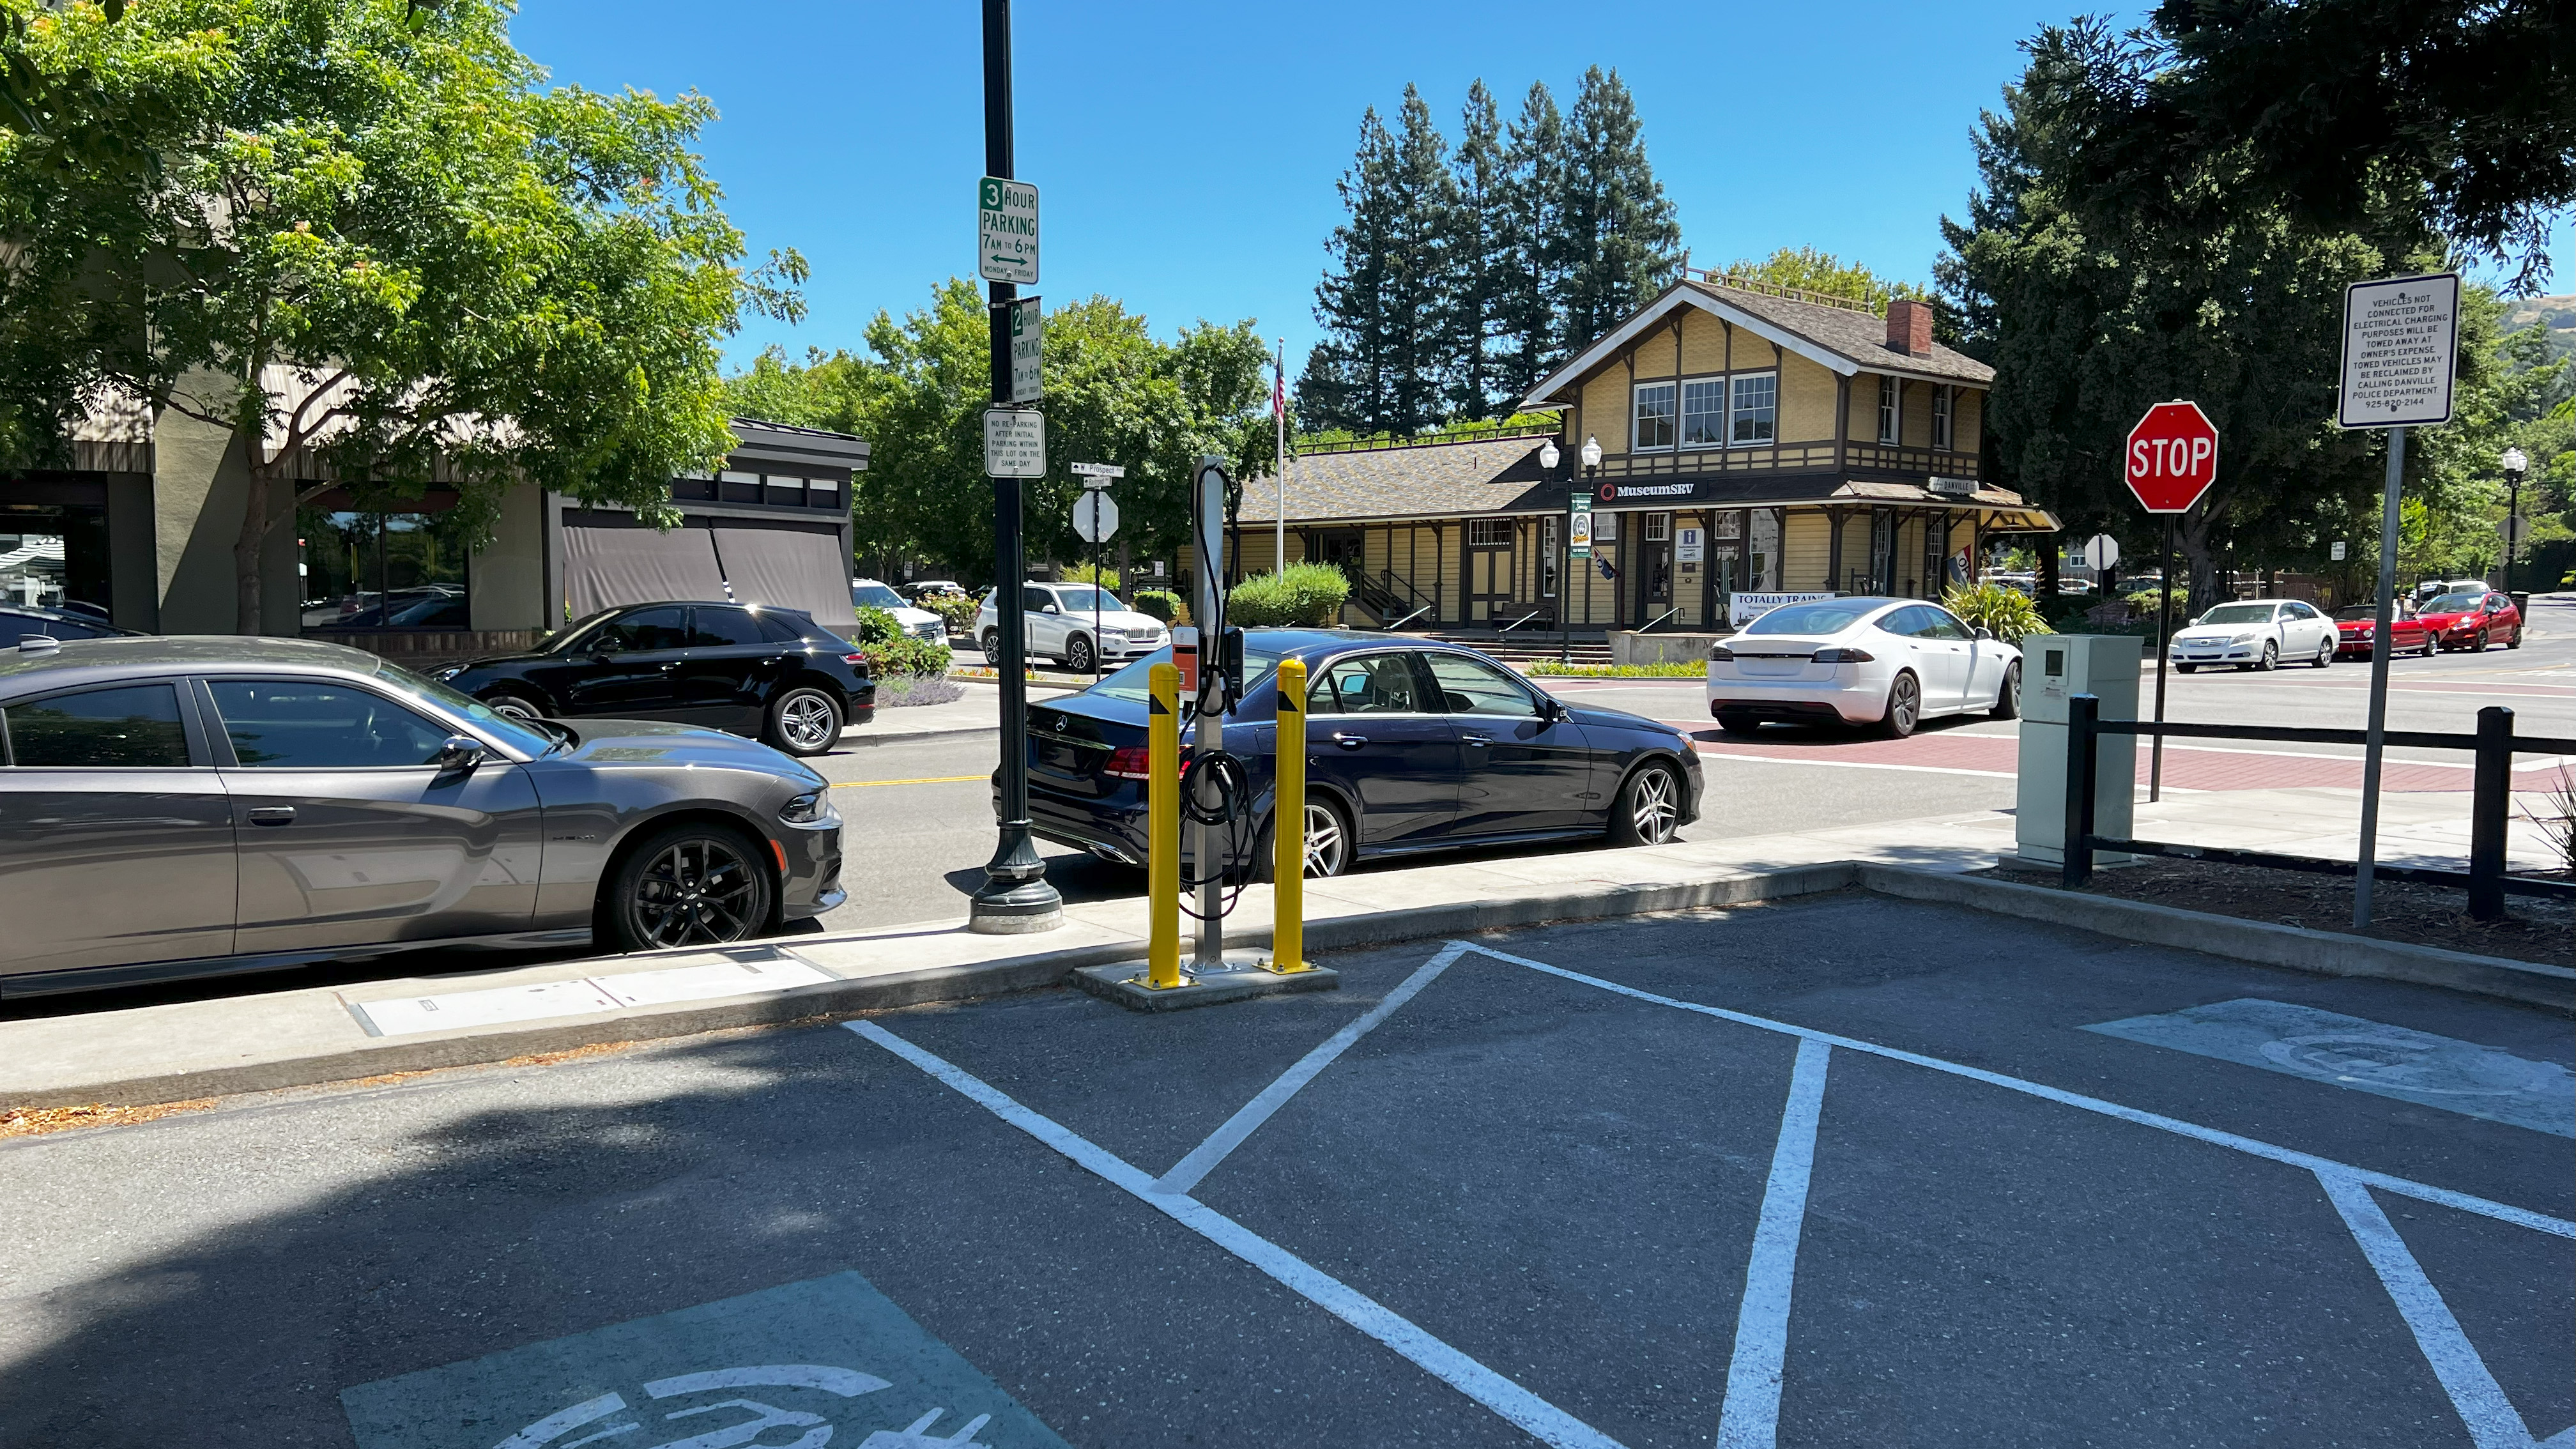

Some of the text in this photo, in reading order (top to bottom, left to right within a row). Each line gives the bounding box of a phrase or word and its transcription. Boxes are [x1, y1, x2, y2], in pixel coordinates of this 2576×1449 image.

[986, 183, 1034, 210] 3 HOUR
[983, 211, 1034, 236] PARKING
[1015, 269, 1034, 278] FRIDAY
[2373, 295, 2431, 307] VEHICLES NOT
[2368, 305, 2435, 318] CONNECTED FOR
[1014, 309, 1038, 331] 2 HOUR
[2354, 314, 2448, 330] ELECTRICAL CHARGING
[2362, 328, 2404, 339] PURPOSES
[2427, 325, 2438, 333] BE
[2366, 335, 2432, 348] TOWED AWAY AT
[1014, 338, 1039, 361] PARKING
[2361, 349, 2396, 359] OWNER'S
[2354, 355, 2442, 369] TOWED VEHICLES MAY
[2373, 367, 2419, 378] RECLAIMED
[2422, 366, 2434, 374] BY
[2358, 376, 2435, 389] CALLING DANVILLE
[2365, 398, 2424, 408] 925-820-2144
[1002, 420, 1037, 429] RE-PARKING
[2131, 437, 2211, 477] STOP
[1089, 464, 1114, 474] Prospect
[1617, 483, 1694, 497] MuseumSRV
[1944, 481, 1969, 491] DANVILLE
[1738, 595, 1783, 604] TOTALLY
